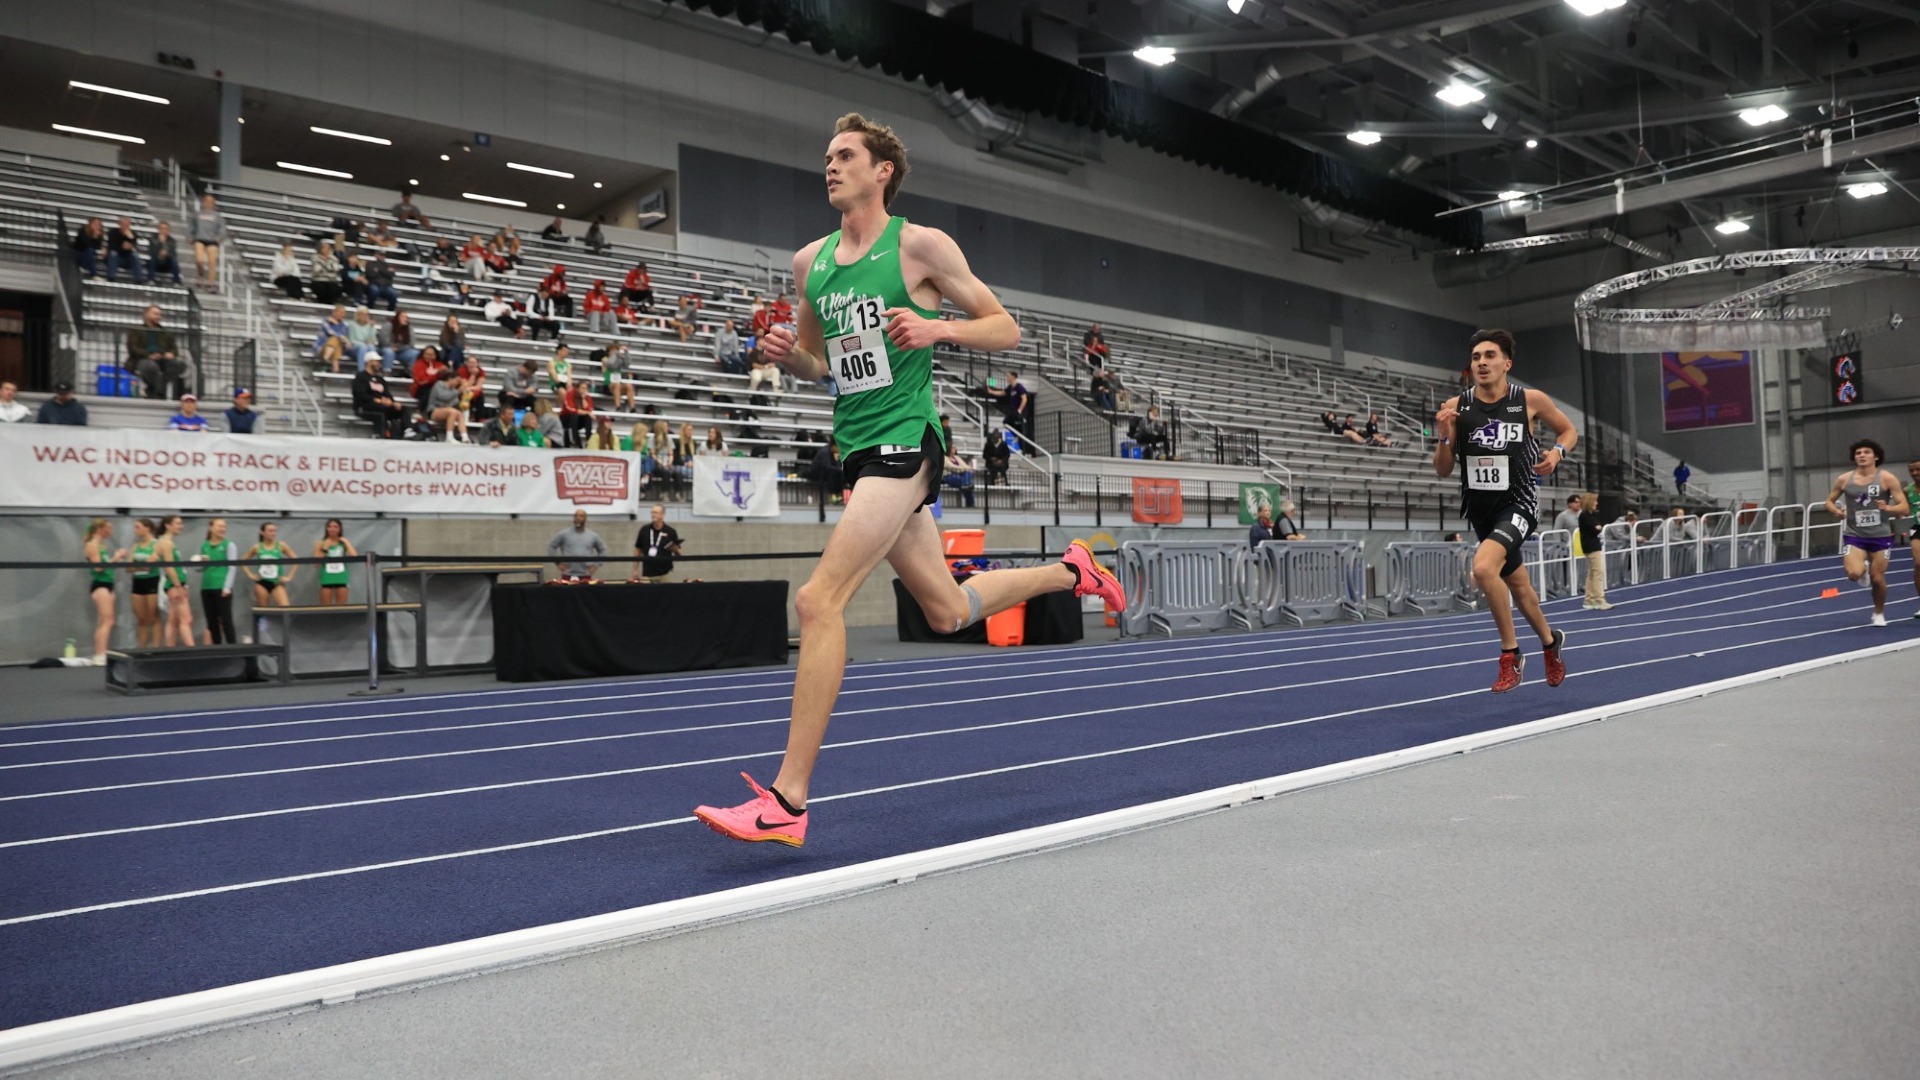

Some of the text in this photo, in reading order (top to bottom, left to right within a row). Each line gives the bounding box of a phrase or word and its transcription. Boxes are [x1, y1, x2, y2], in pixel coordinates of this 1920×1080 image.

[817, 287, 855, 321] Utah
[856, 301, 880, 331] 13
[841, 351, 877, 381] 406
[1502, 424, 1519, 441] 15
[33, 445, 542, 478] WAC INDOOR TRACK & FIELD CHAMPIONSHIPS
[561, 462, 624, 487] WAC
[87, 471, 507, 498] WACSports.com @WACSports #WACitf
[1475, 468, 1500, 484] 118
[1139, 487, 1175, 514] UT
[1870, 486, 1877, 496] 3
[1517, 516, 1528, 534] 15
[1861, 515, 1875, 523] 281
